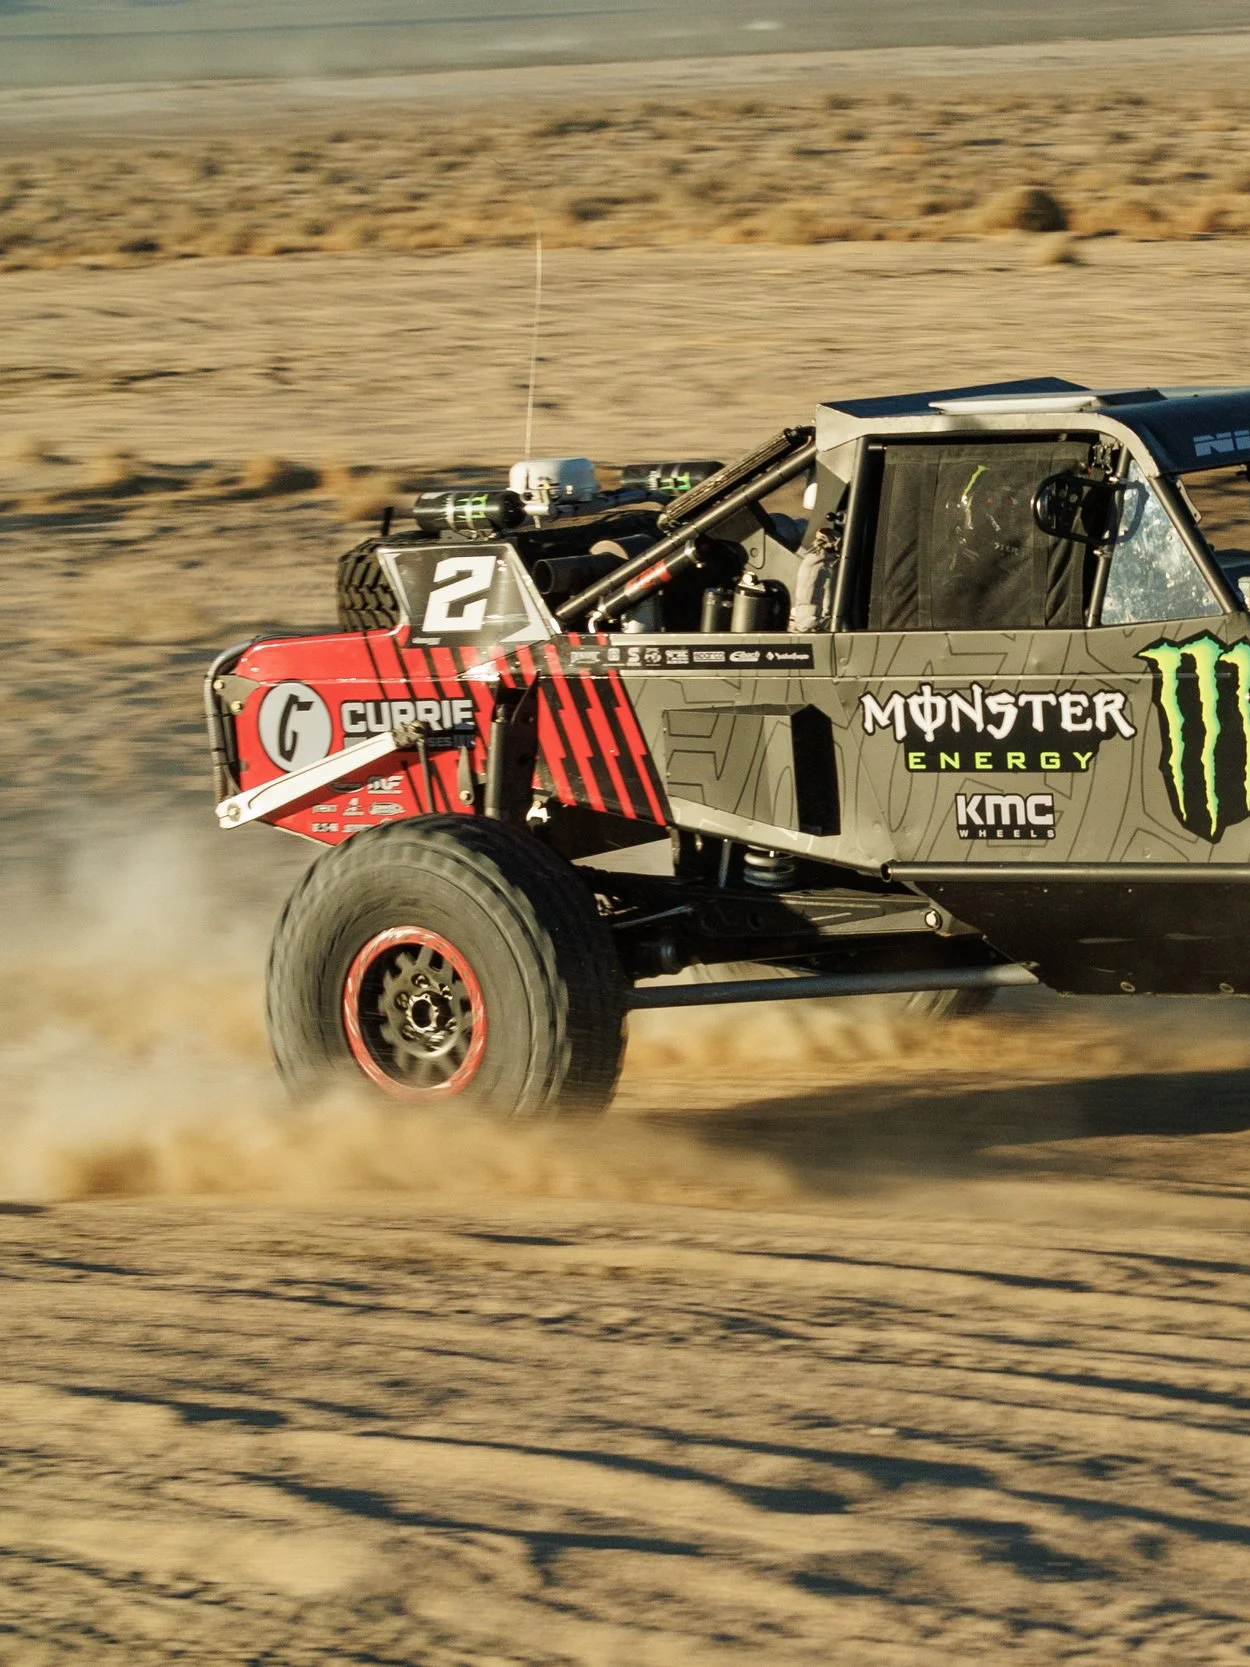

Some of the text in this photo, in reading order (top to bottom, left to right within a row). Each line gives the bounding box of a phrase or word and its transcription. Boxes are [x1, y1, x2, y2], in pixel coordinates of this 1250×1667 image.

[422, 556, 496, 631] 2
[341, 700, 473, 733] CURRIE
[860, 683, 1136, 742] MONSTER
[908, 752, 1093, 770] ENERGY
[959, 829, 1056, 838] WHEELS
